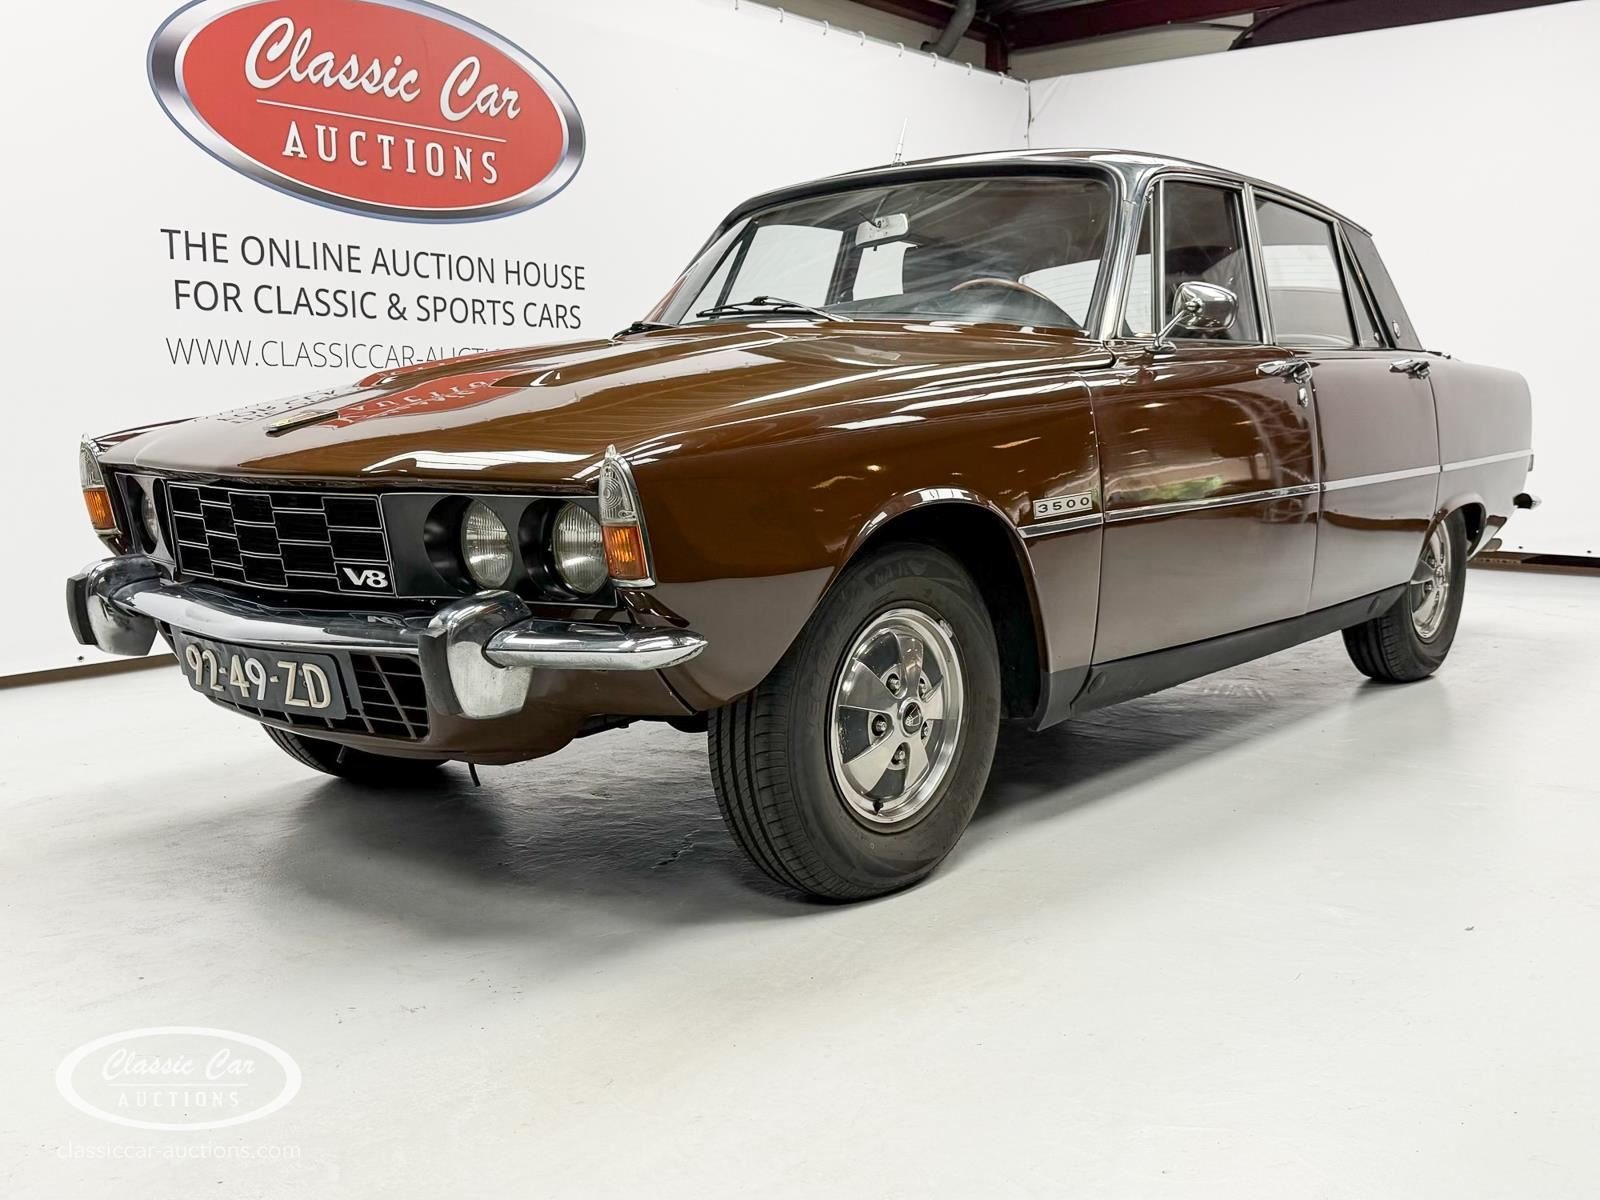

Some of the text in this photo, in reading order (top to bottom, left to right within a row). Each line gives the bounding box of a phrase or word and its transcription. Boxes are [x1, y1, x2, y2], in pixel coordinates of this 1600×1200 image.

[244, 17, 521, 121] Classic Car
[282, 121, 498, 184] AUCTIONS
[160, 228, 586, 290] THE ONLINE AUCTION HOUSE
[174, 279, 582, 330] FOR CLASSIC & SPORTS CARS
[1037, 497, 1090, 513] 3500
[342, 567, 388, 588] V8
[185, 643, 332, 709] 92-49-ZD
